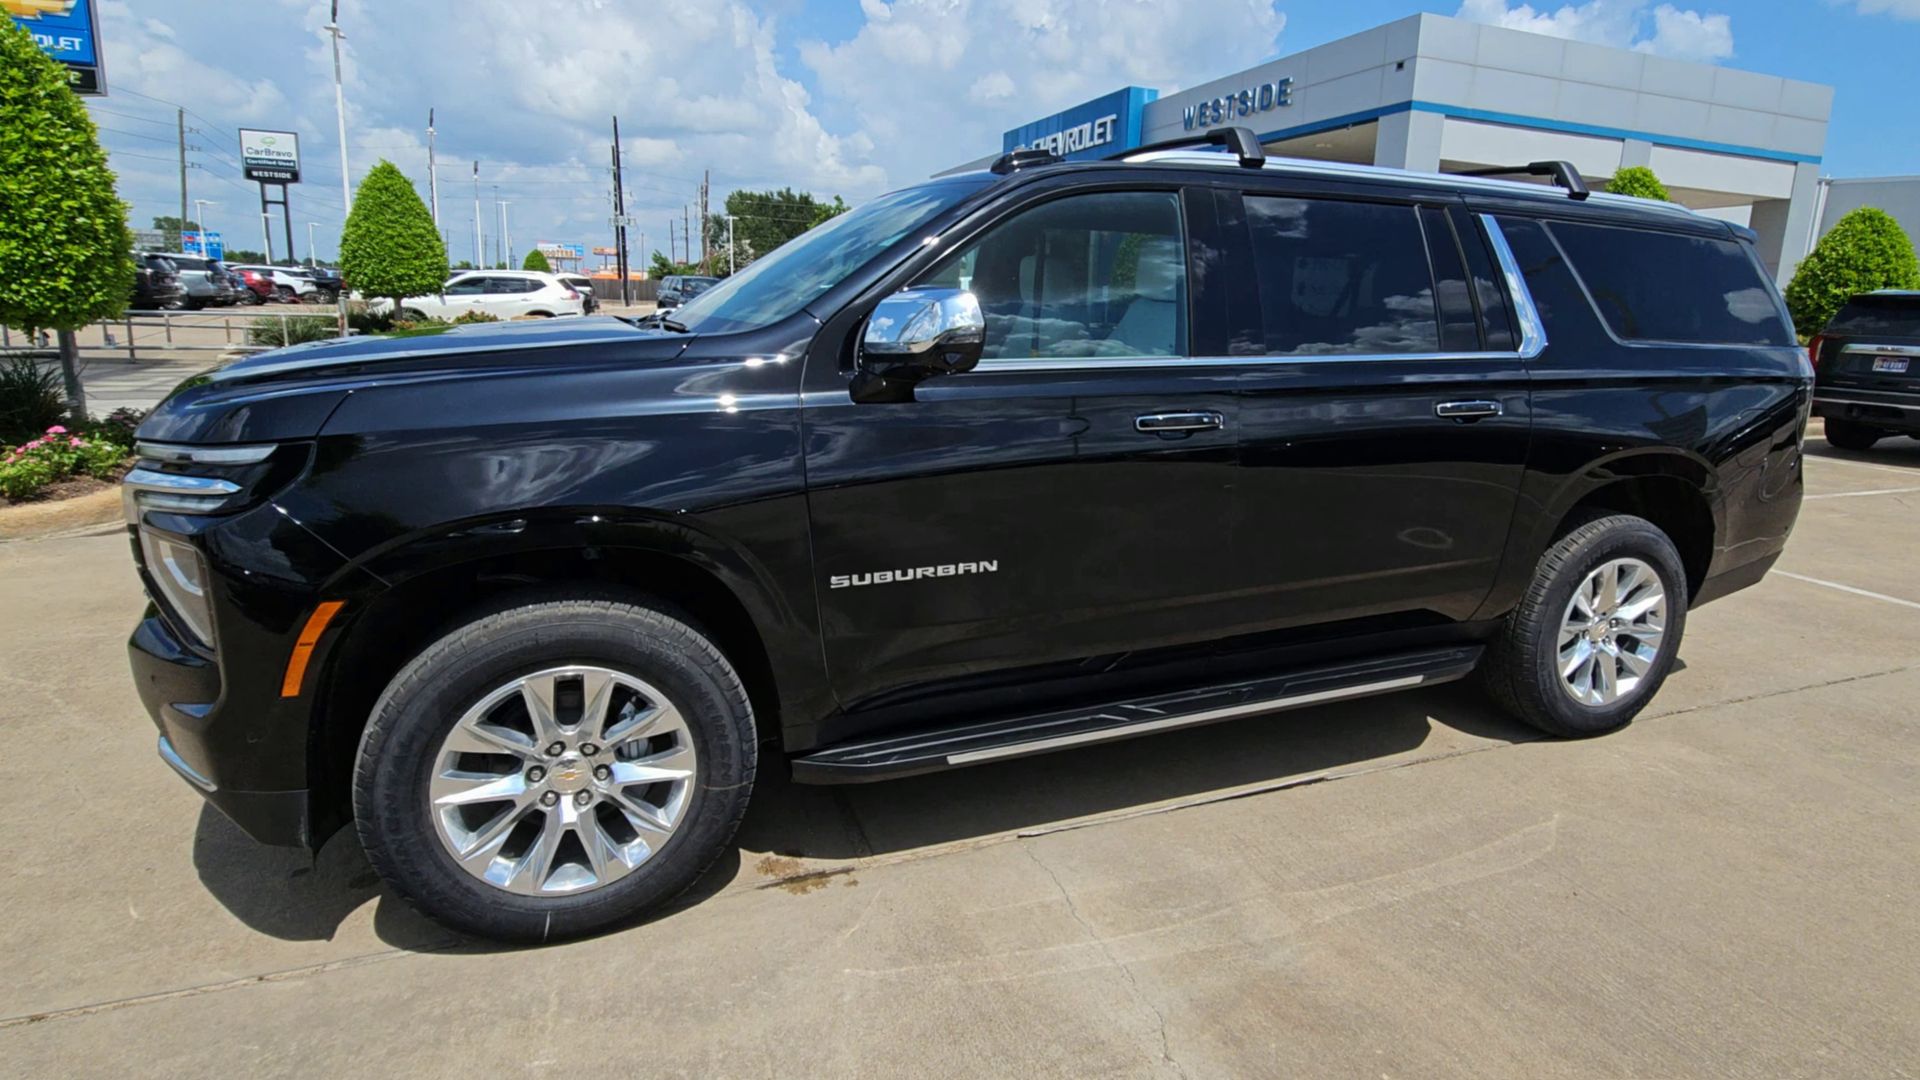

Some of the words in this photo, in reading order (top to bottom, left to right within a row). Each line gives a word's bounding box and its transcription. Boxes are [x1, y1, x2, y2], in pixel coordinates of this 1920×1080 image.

[1183, 76, 1294, 131] WESTSIDE
[246, 147, 293, 157] CarBravo
[251, 170, 292, 179] WESTSIDE
[830, 559, 998, 589] SUBURBAN
